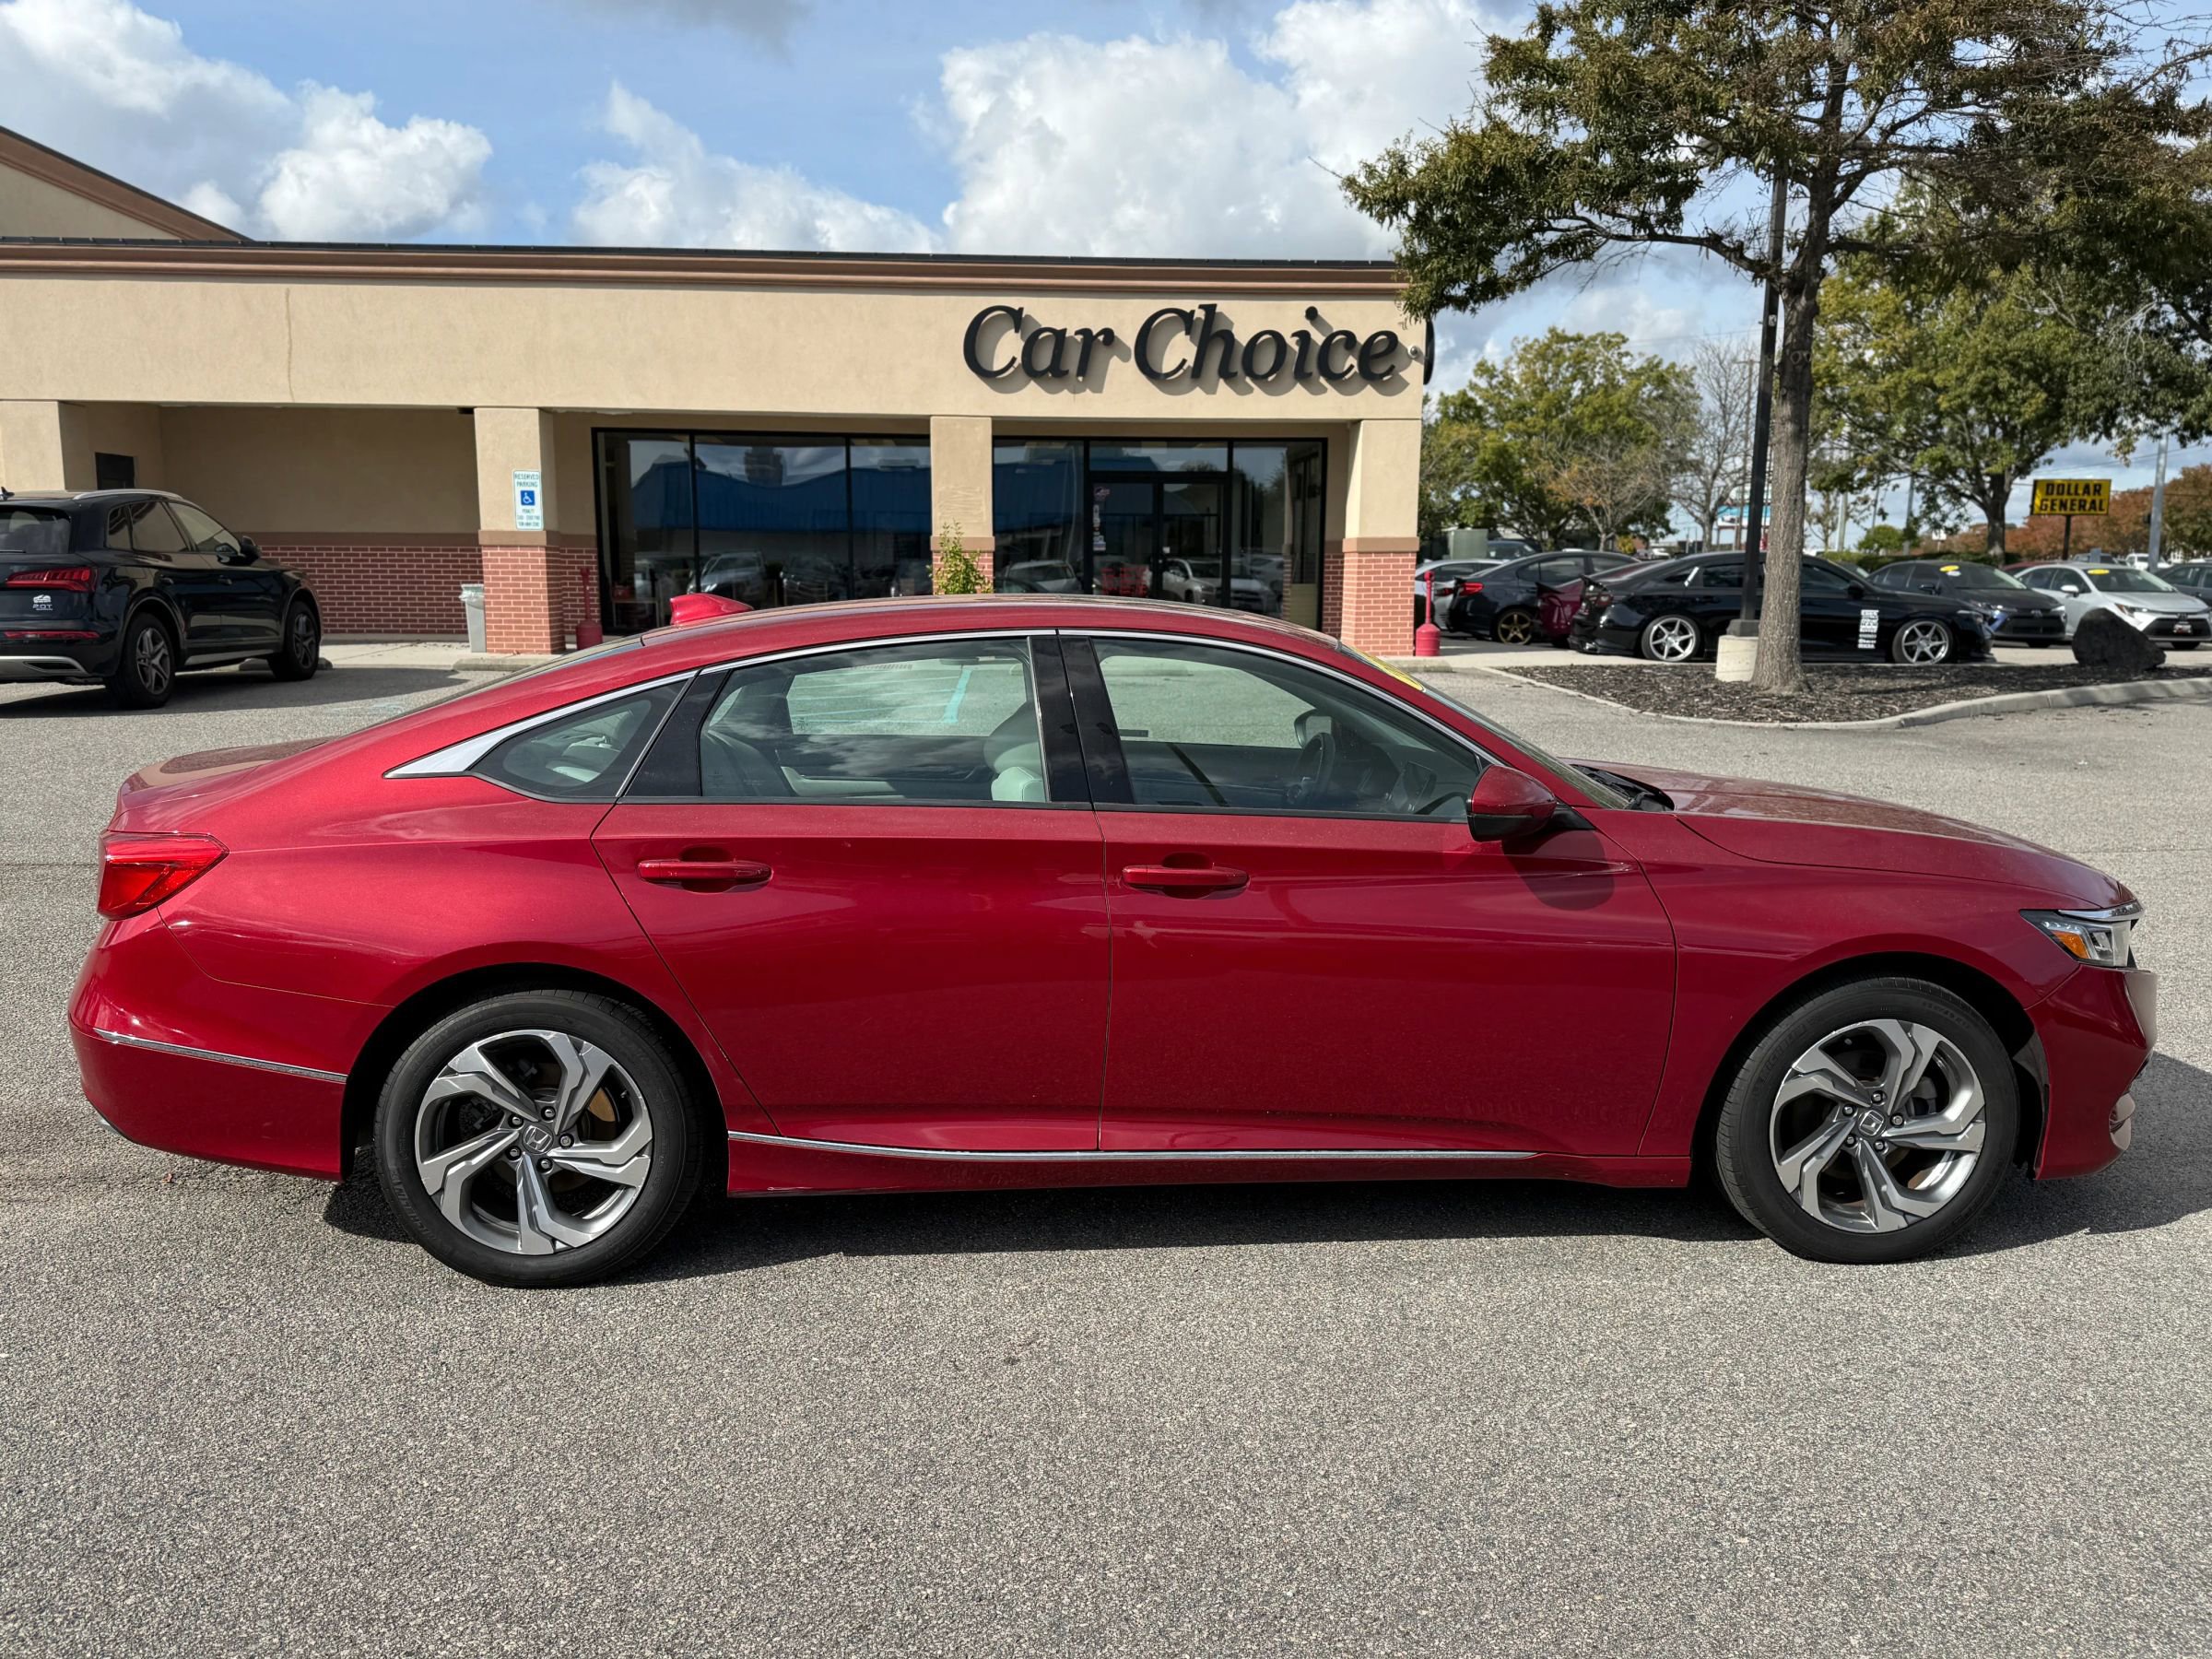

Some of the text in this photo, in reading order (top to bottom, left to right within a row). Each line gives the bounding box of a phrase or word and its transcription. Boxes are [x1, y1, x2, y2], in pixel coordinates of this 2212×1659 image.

[963, 303, 1399, 382] Car Choice
[2045, 483, 2102, 496] DOLLAR
[2040, 499, 2105, 512] GENERAL
